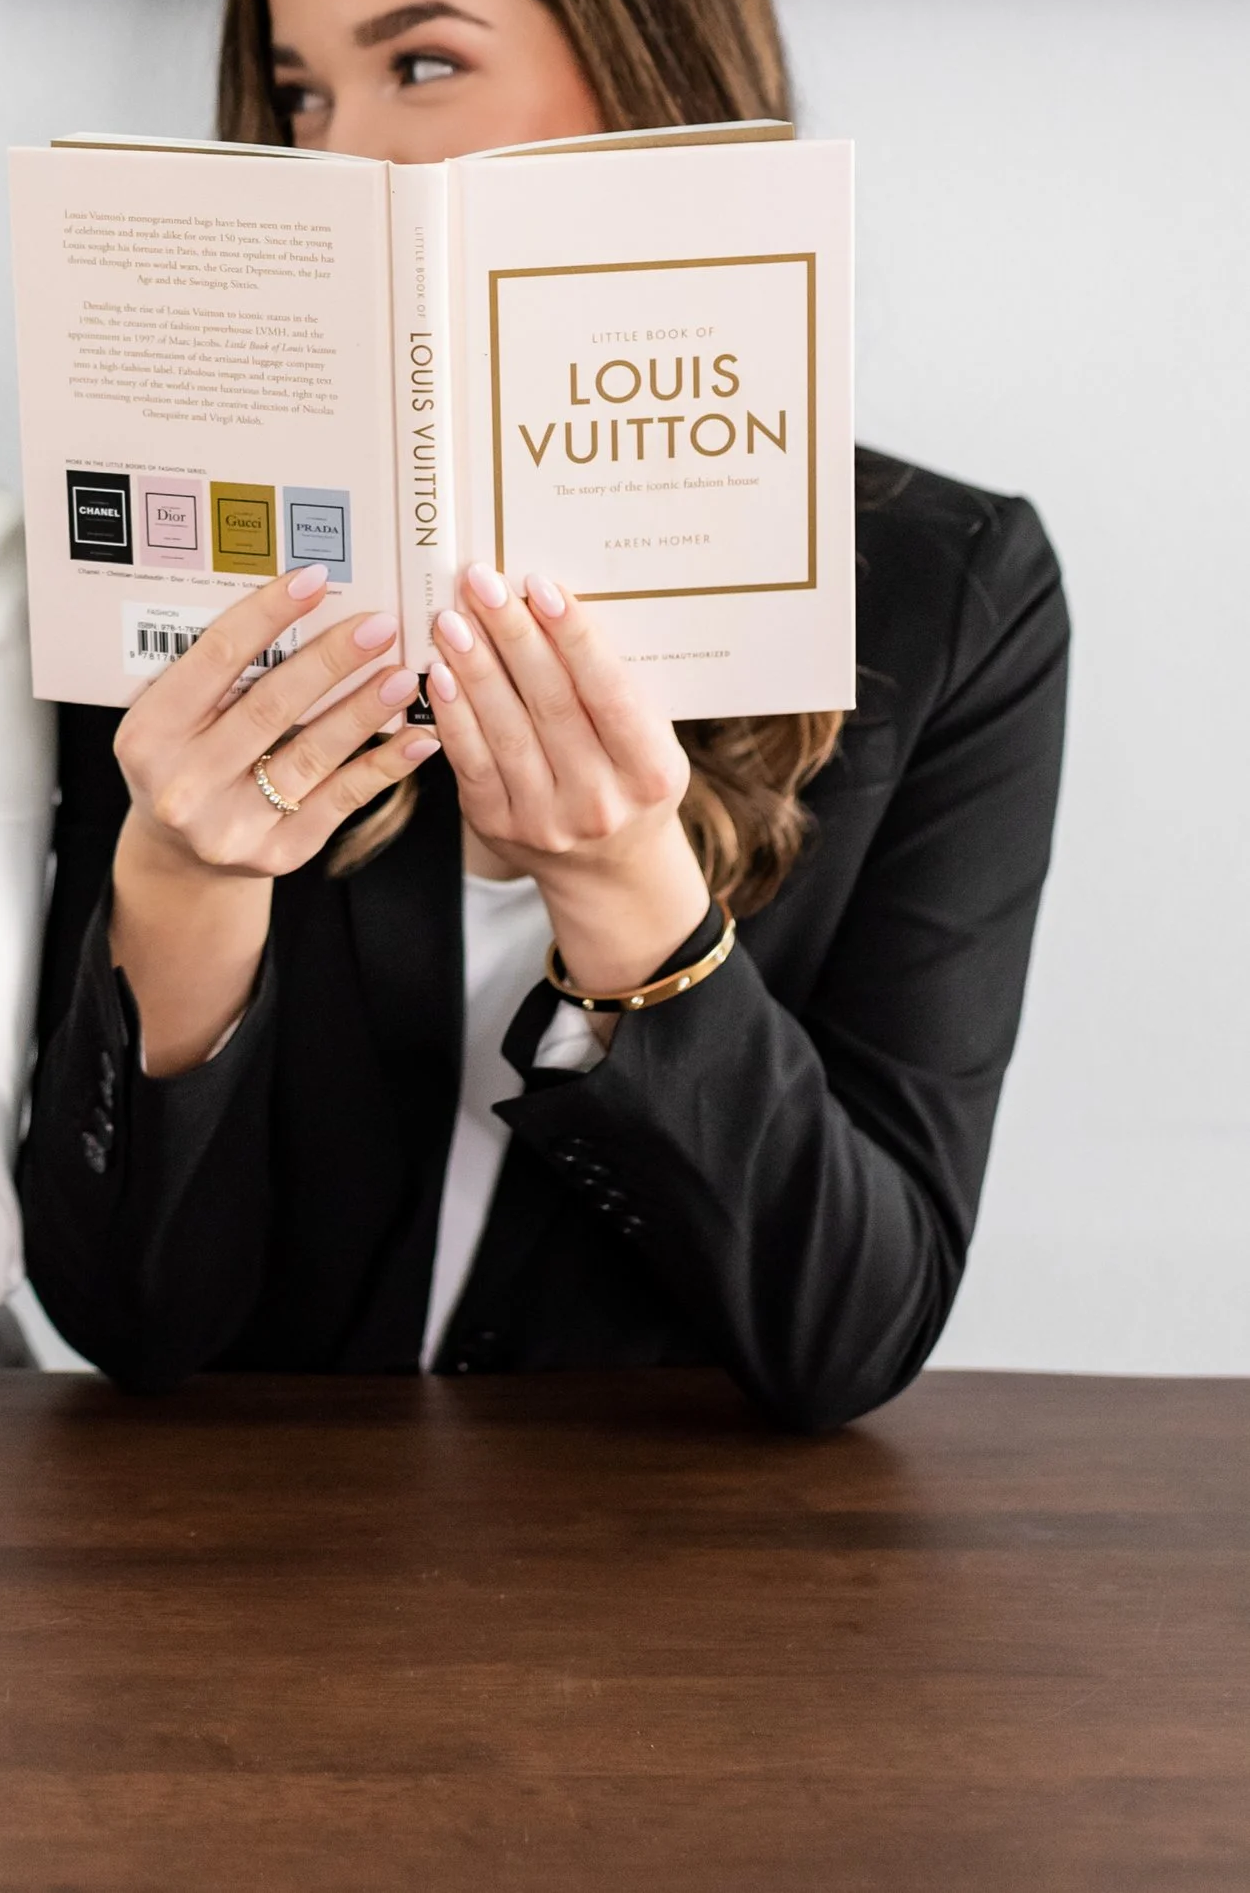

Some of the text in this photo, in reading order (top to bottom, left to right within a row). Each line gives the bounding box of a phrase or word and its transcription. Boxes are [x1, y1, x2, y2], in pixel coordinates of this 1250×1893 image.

[415, 226, 424, 262] LITTLE
[415, 267, 426, 299] BOOK
[592, 325, 713, 343] LITTLE BOOK OF
[570, 354, 740, 405] LOUIS
[410, 332, 438, 546] LOUIS VUITTON
[518, 410, 787, 467] VUITTON
[554, 476, 759, 496] The story of the iconic fashion house
[79, 506, 121, 518] CHANEL
[157, 508, 186, 522] Dior
[225, 514, 262, 529] Gucci
[297, 523, 339, 534] PRADA
[604, 533, 710, 549] KAREN HOMER
[662, 651, 730, 660] UNAUTHORIZED
